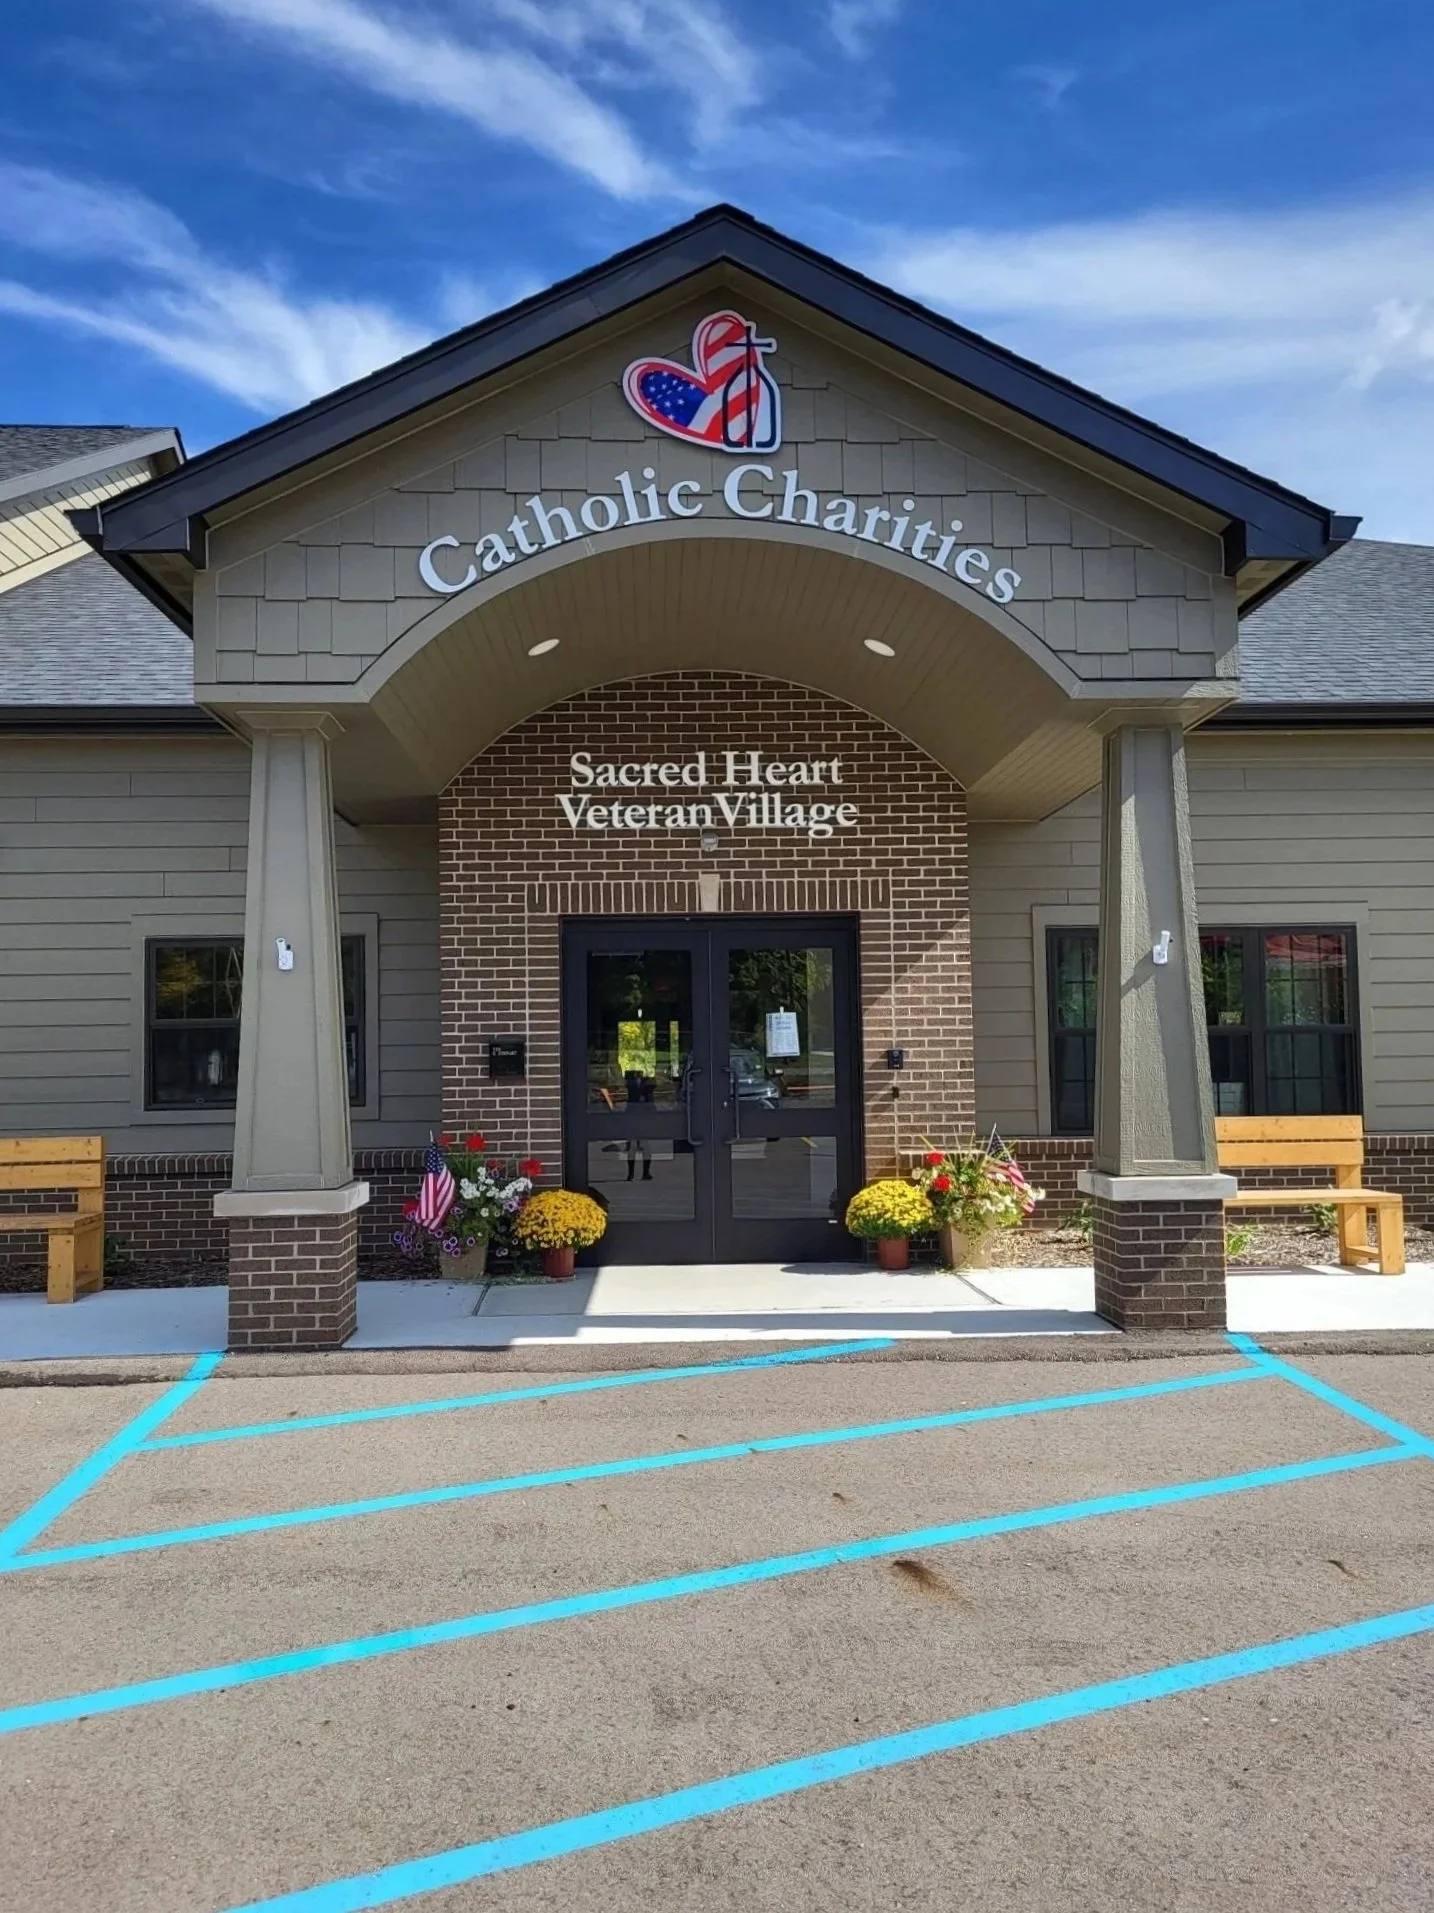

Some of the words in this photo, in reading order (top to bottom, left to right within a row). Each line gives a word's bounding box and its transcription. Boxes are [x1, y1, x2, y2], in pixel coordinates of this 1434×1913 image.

[418, 466, 704, 595] Catholic
[722, 463, 1022, 605] Charities
[570, 751, 709, 787] Sacred
[721, 751, 844, 786] Heart
[555, 793, 716, 828] Veteran
[712, 792, 859, 838] Village
